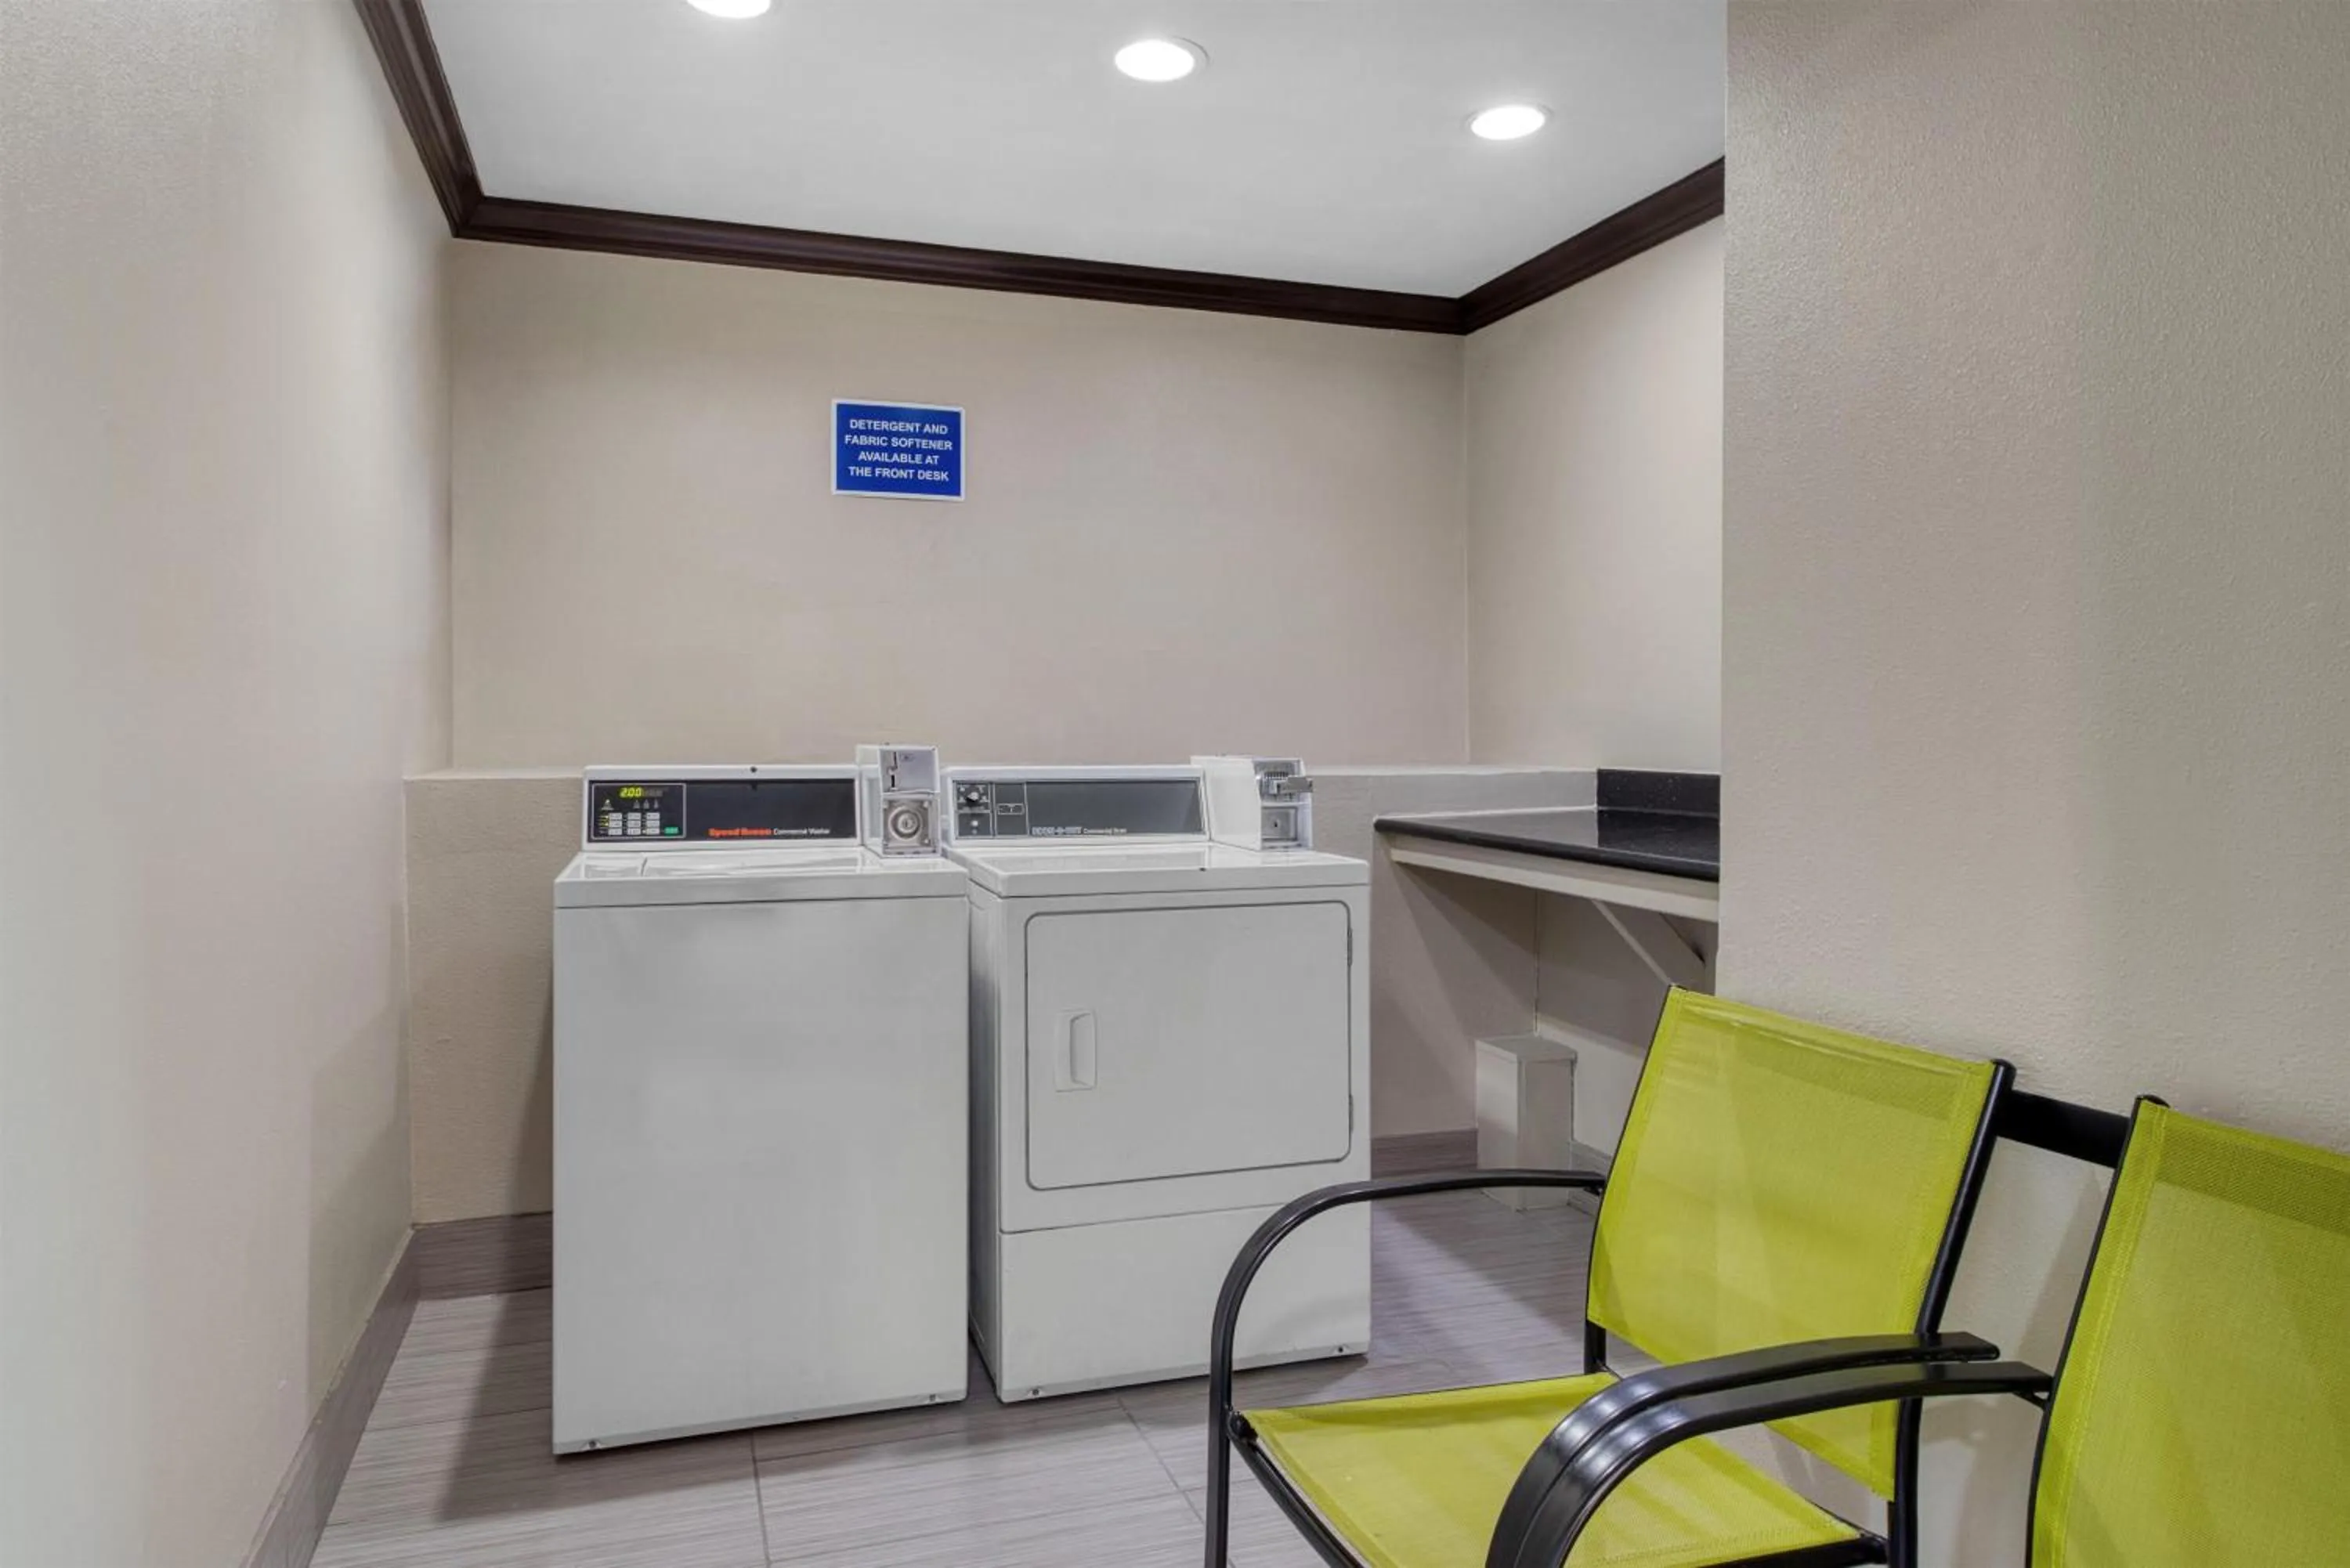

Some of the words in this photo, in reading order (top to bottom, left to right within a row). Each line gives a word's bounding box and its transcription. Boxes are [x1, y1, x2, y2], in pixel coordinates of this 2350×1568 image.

[850, 419, 920, 433] DETERGENT
[924, 424, 948, 435] AND
[845, 435, 888, 446] FABRIC
[891, 437, 953, 450] SOFTENER
[858, 451, 923, 464] AVAILABLE
[925, 455, 939, 464] AT
[848, 466, 872, 477] THE
[875, 468, 915, 479] FRONT
[917, 470, 949, 482] DESK
